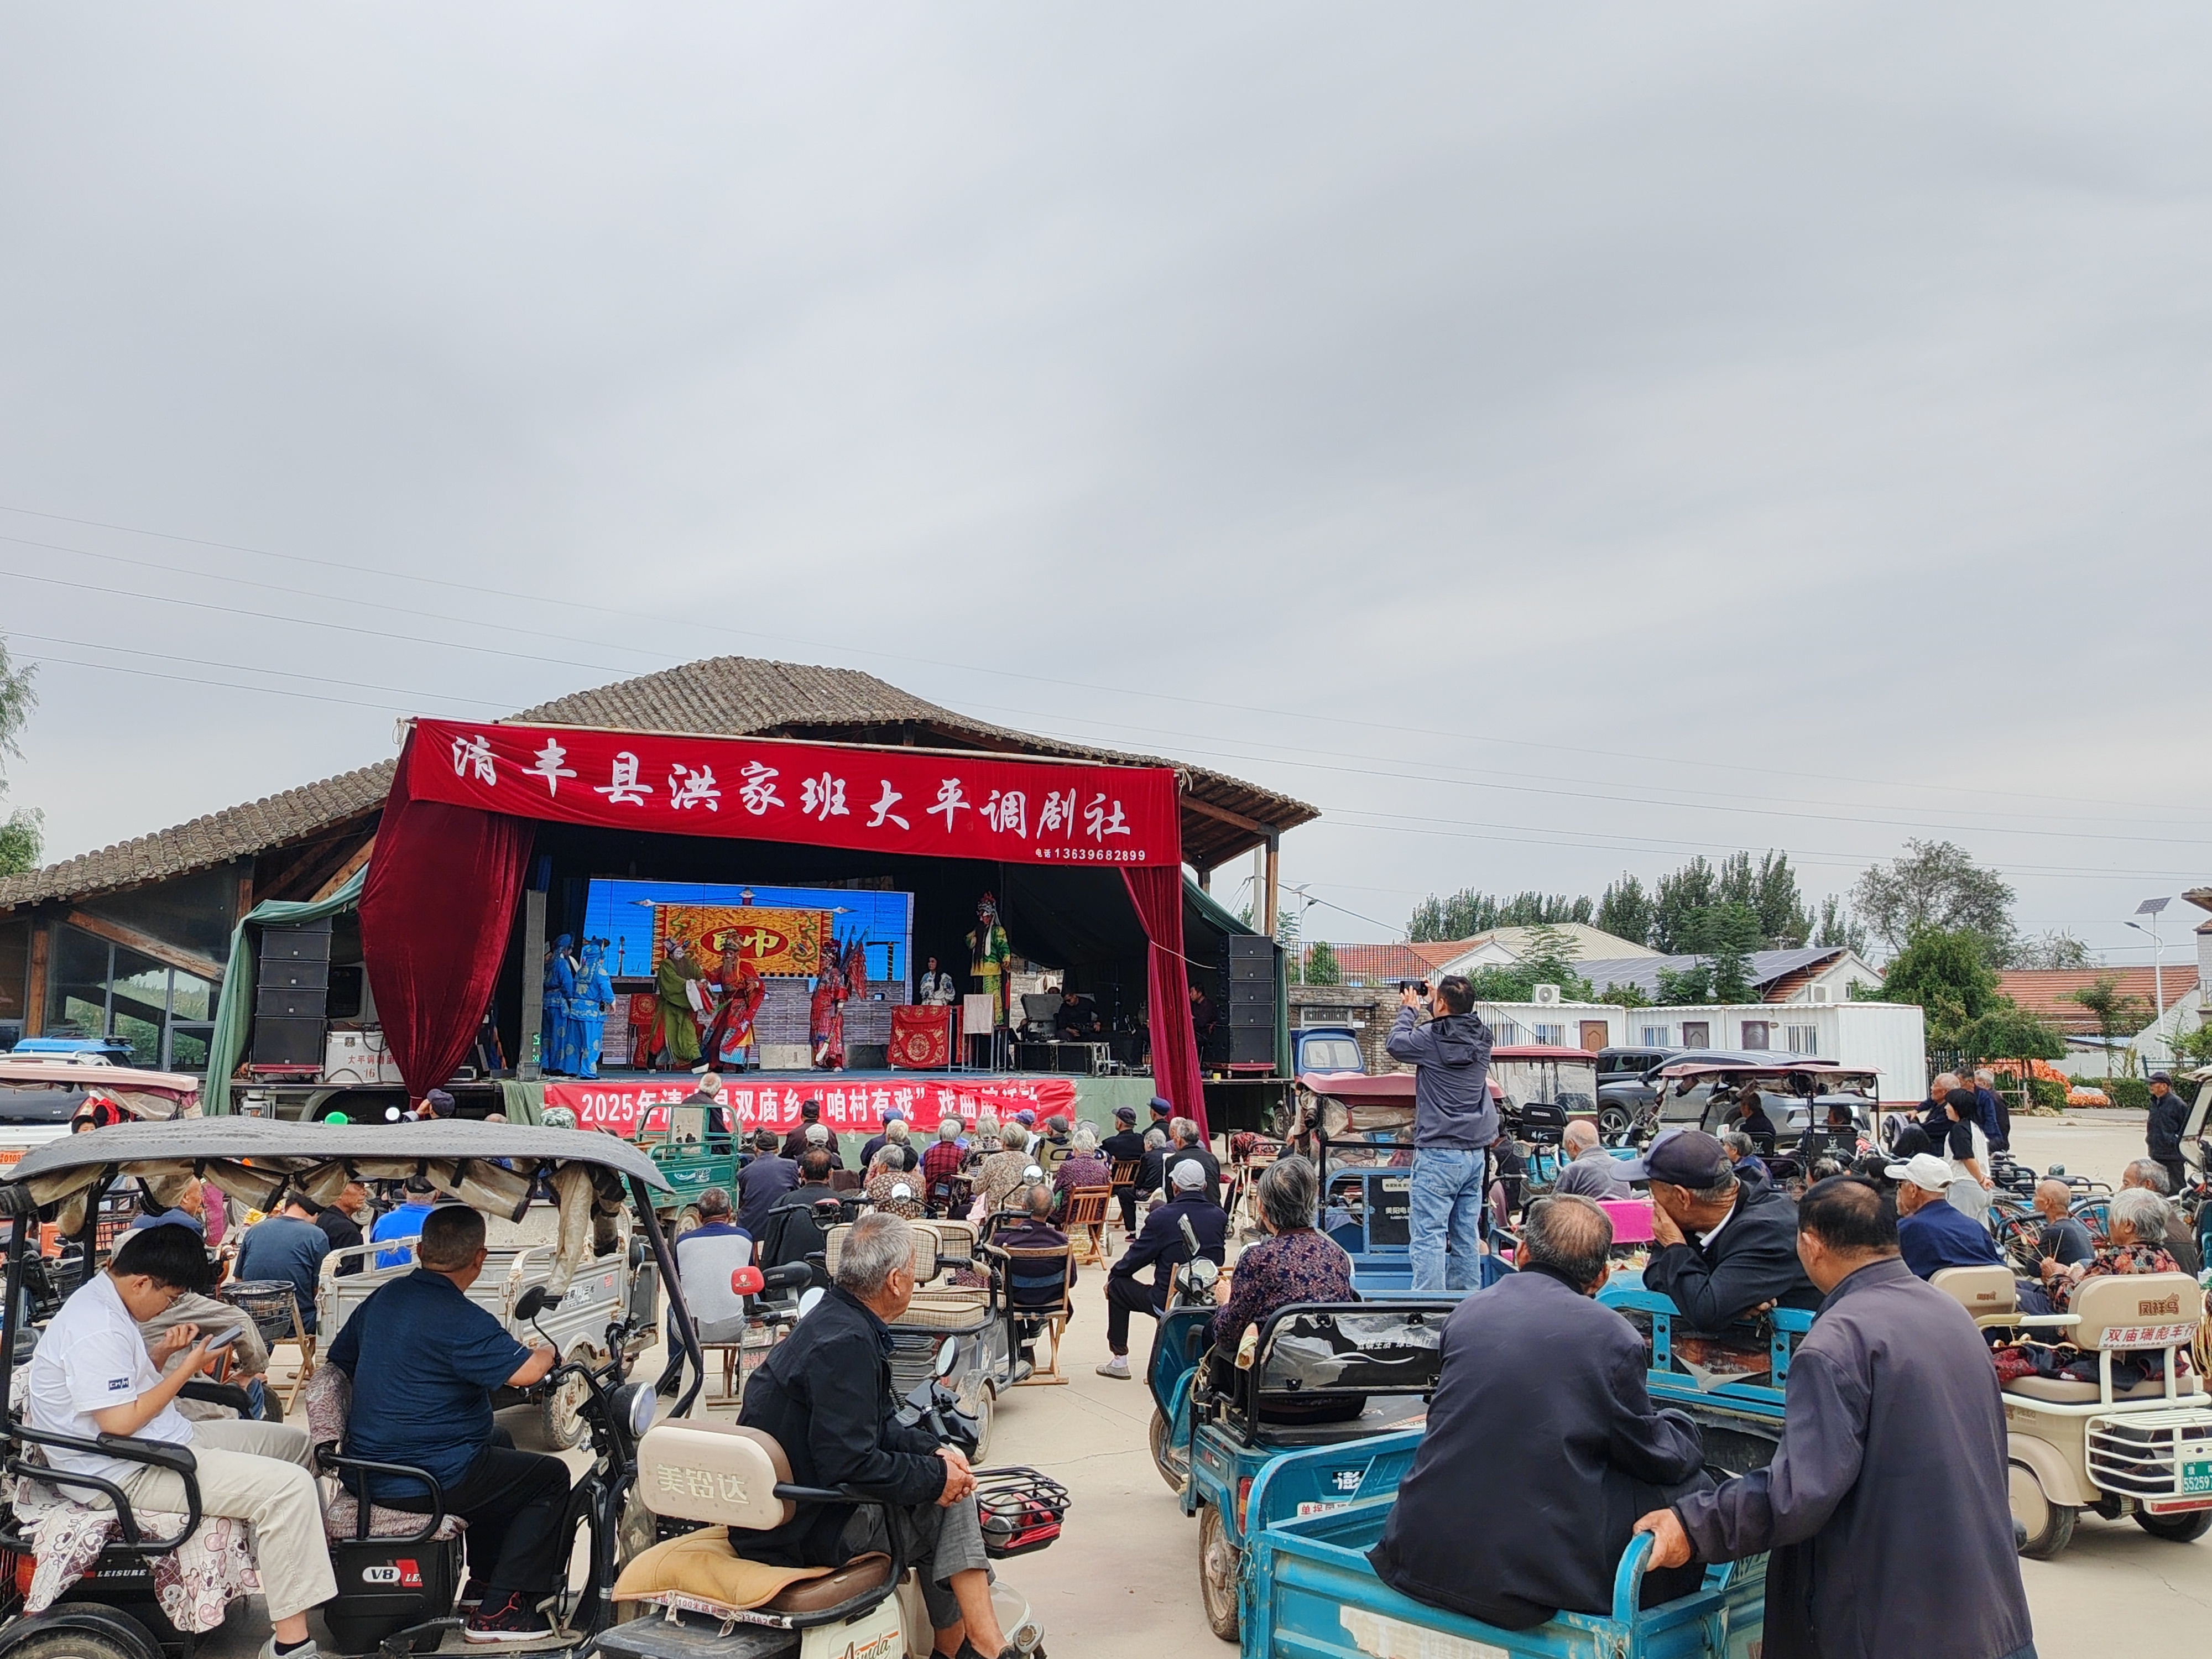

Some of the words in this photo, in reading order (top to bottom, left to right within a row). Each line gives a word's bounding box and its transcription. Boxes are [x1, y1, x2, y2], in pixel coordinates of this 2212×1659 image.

[451, 735, 1130, 842] 清丰县洪家班大平调剧社
[97, 1569, 147, 1577] LEISURE
[371, 1569, 394, 1579] V8
